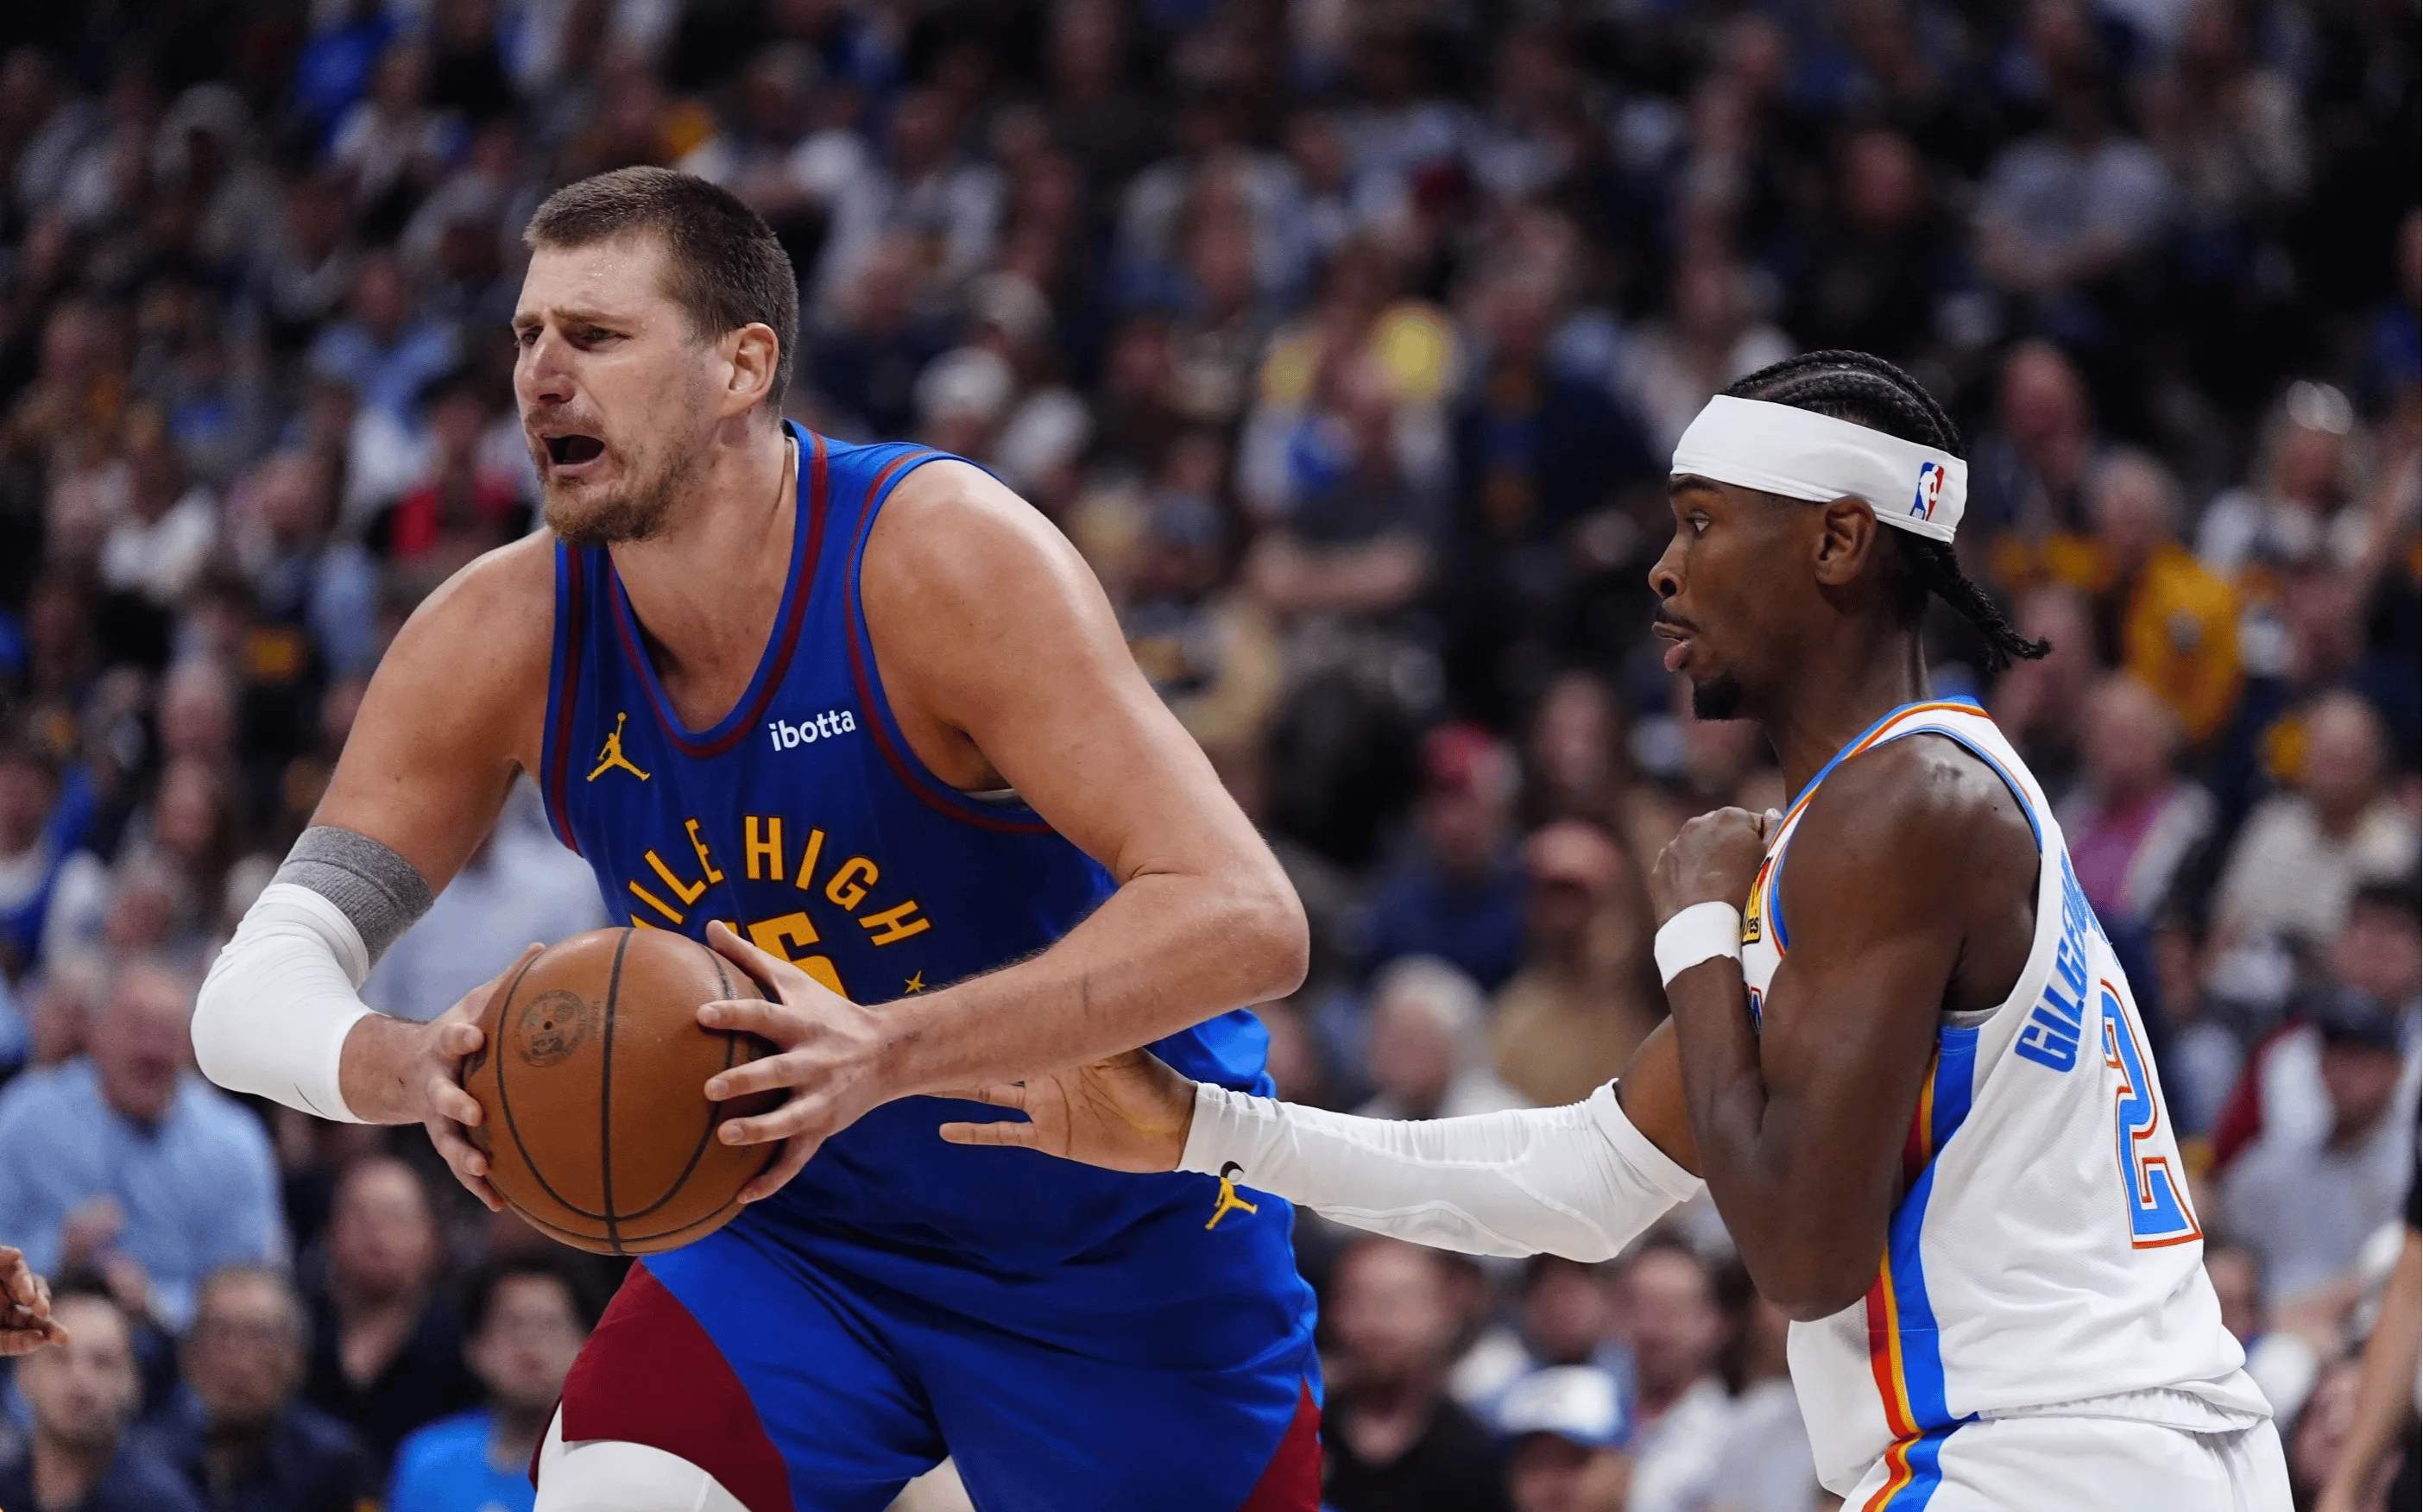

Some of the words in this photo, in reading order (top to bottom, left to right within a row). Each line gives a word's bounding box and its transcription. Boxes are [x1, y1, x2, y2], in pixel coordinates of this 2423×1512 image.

[768, 710, 856, 751] ibotta
[629, 818, 725, 929] ILE
[744, 816, 931, 946] HIGH
[2101, 979, 2203, 1249] 2
